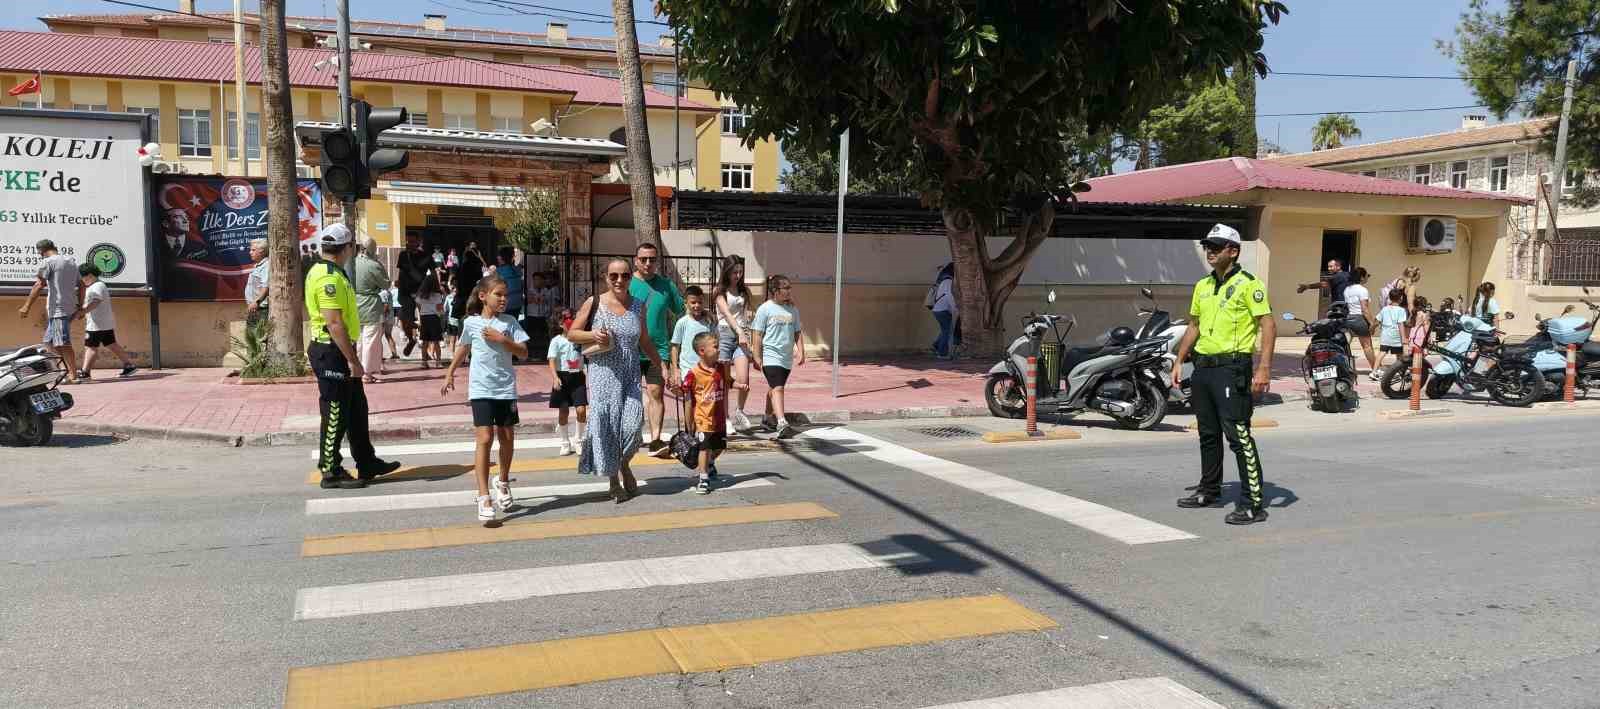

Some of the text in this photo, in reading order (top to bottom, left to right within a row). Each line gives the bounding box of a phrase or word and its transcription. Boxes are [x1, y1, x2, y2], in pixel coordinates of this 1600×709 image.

[4, 136, 114, 160] KOLEJİ
[22, 212, 56, 224] Yıllık
[201, 210, 223, 231] İlk
[225, 211, 255, 229] Ders
